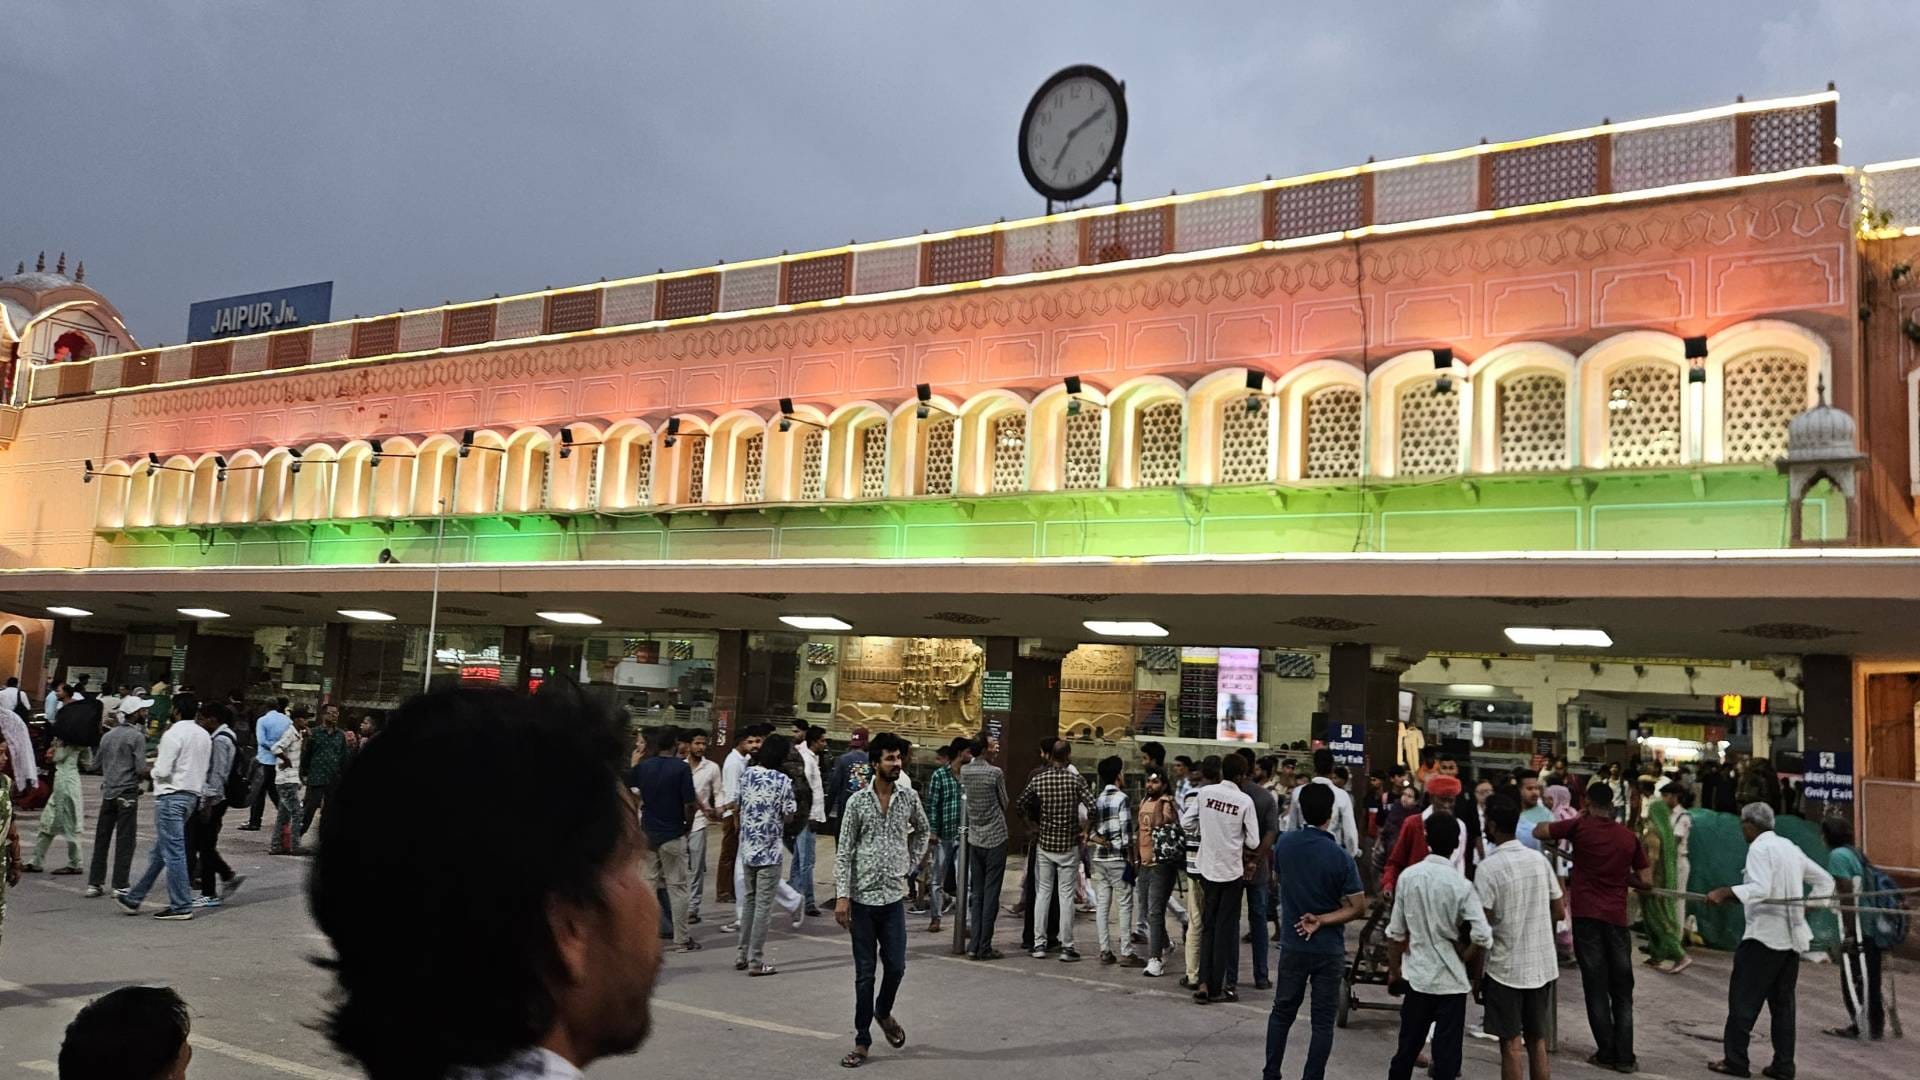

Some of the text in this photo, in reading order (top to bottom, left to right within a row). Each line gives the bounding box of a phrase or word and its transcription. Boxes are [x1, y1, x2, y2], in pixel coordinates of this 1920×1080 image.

[1070, 84, 1081, 99] 12
[1053, 94, 1063, 109] 11
[210, 302, 273, 333] JAIPUR
[1804, 786, 1830, 799] Only
[1205, 797, 1240, 816] WHITE
